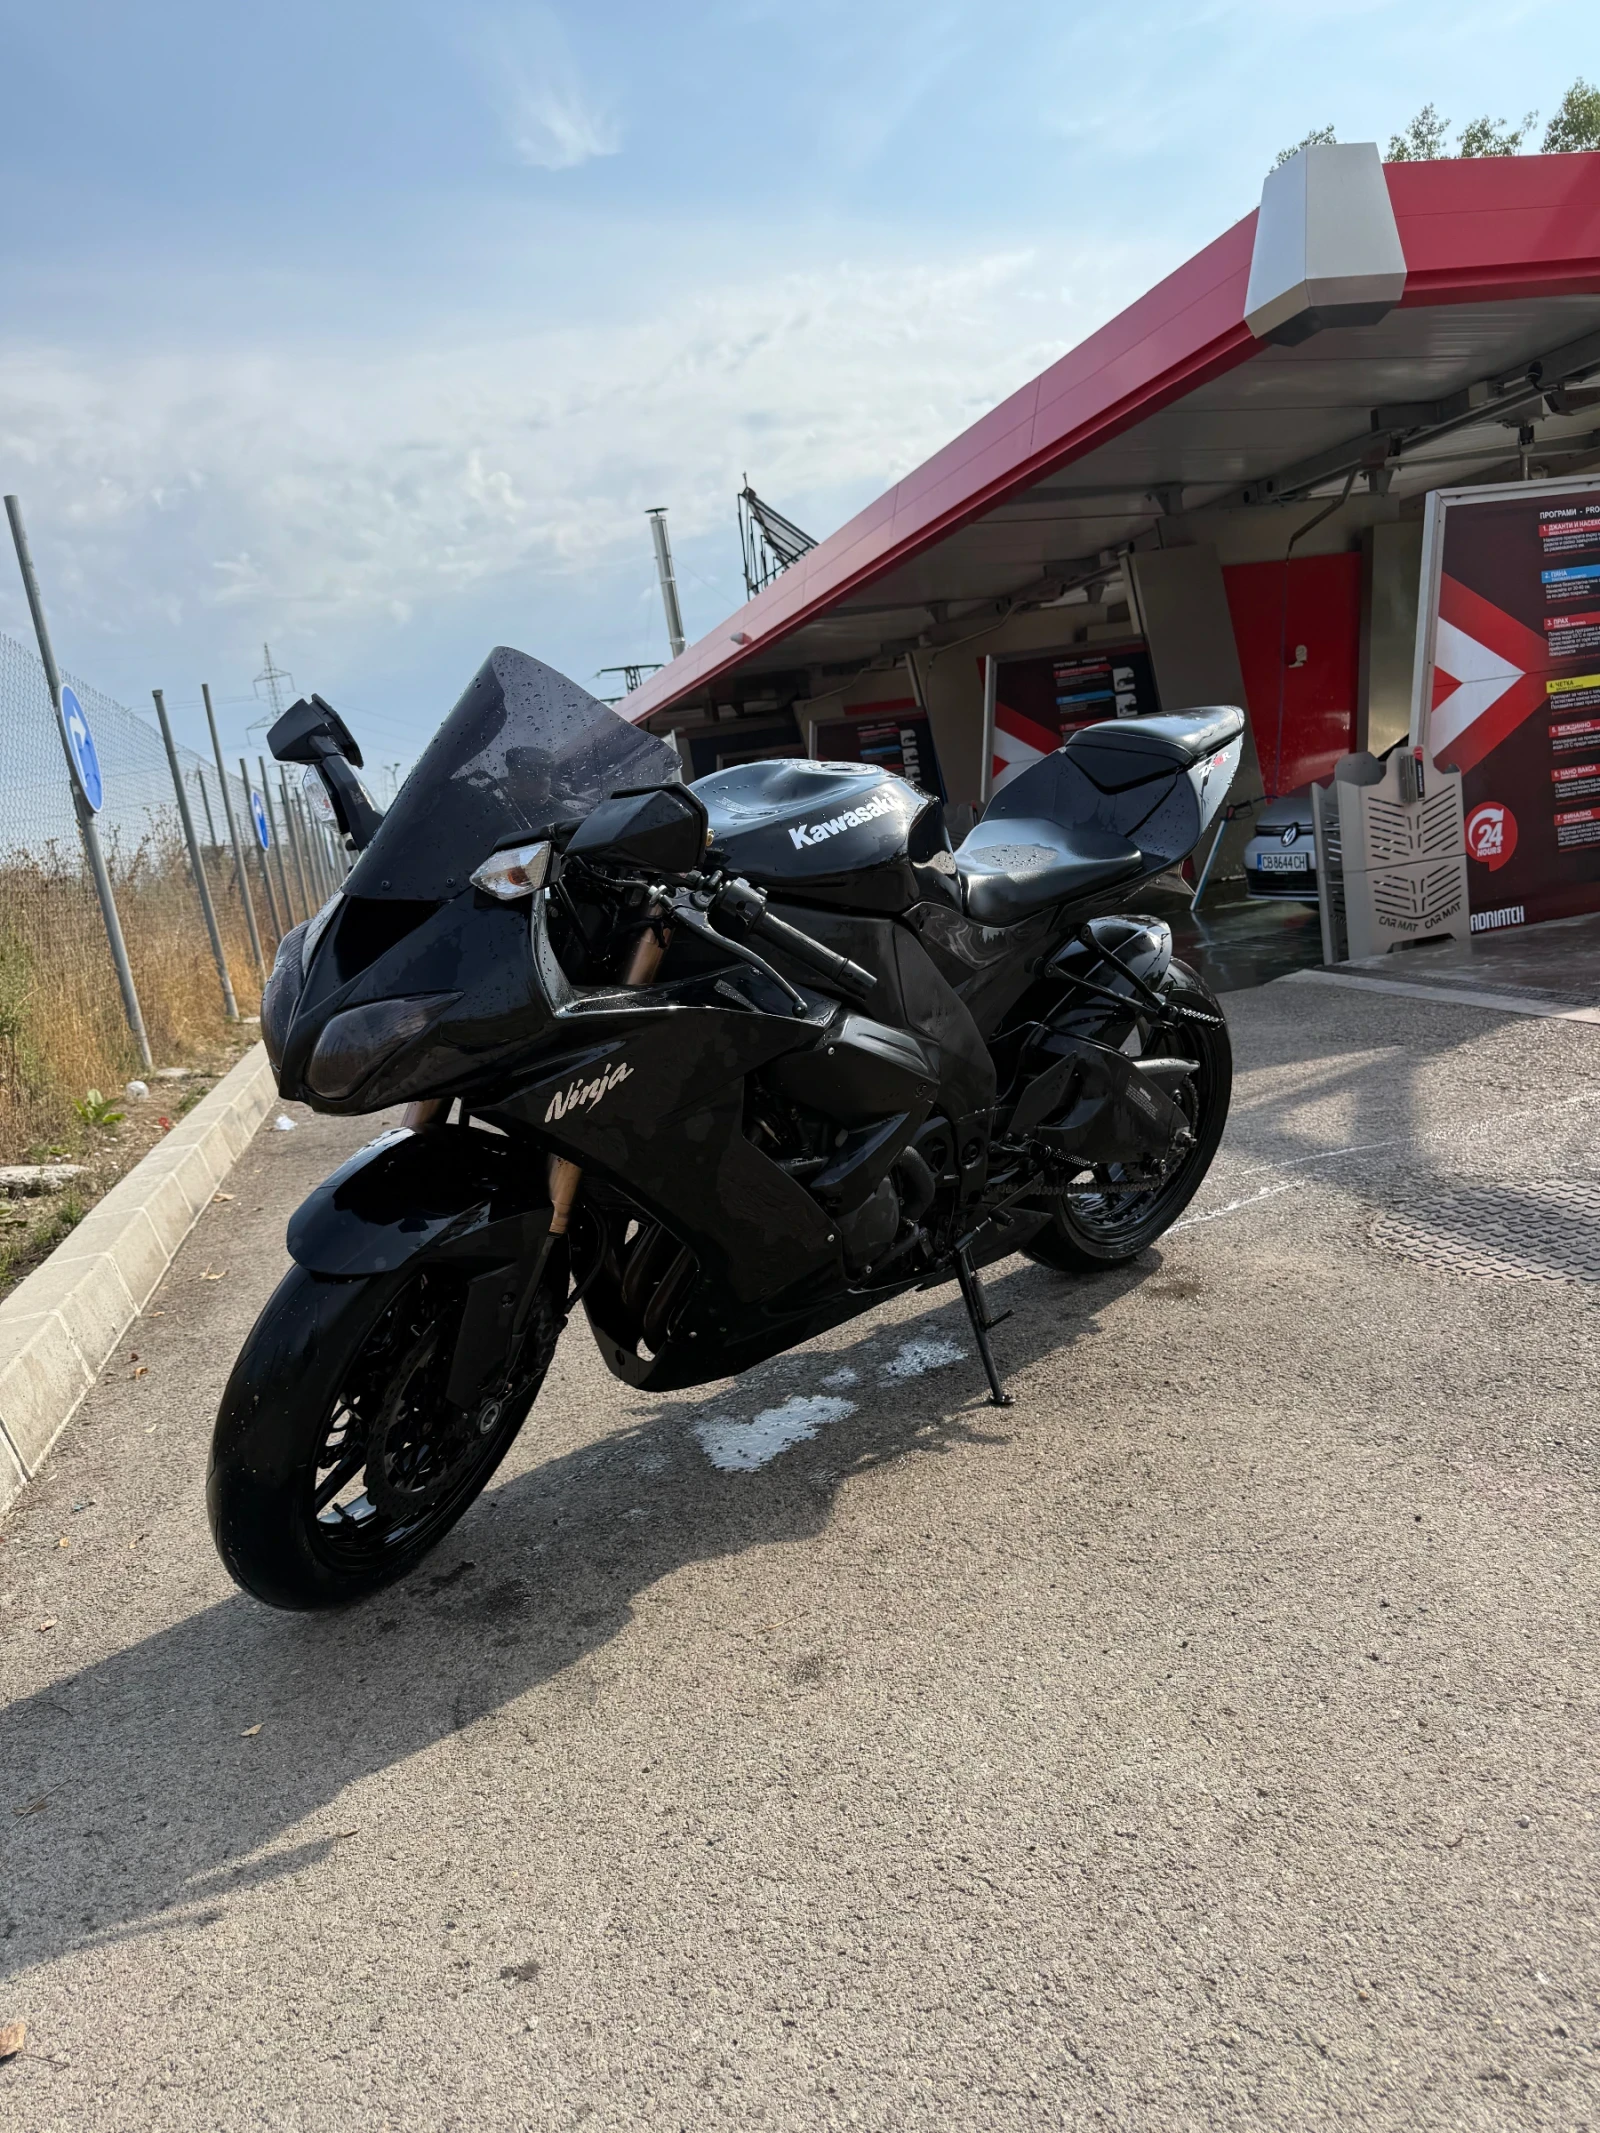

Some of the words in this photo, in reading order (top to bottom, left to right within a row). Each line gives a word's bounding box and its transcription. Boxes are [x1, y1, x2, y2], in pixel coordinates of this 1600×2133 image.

[1540, 508, 1576, 519] ПРОГРАМИ
[1549, 522, 1574, 531] ДЖАНТИ
[1554, 617, 1568, 625] ПРАХ
[1558, 721, 1591, 731] МЕЖДИННО
[1563, 810, 1591, 820] ФИНАЛНО
[788, 792, 897, 850] Kawasaki
[1478, 822, 1503, 849] 24
[1477, 846, 1502, 857] HOURS
[1424, 914, 1442, 929] CAR
[1442, 902, 1461, 919] MAT
[1379, 916, 1397, 928] CAR
[1398, 921, 1418, 932] MAT
[544, 1062, 635, 1123] Ninja
